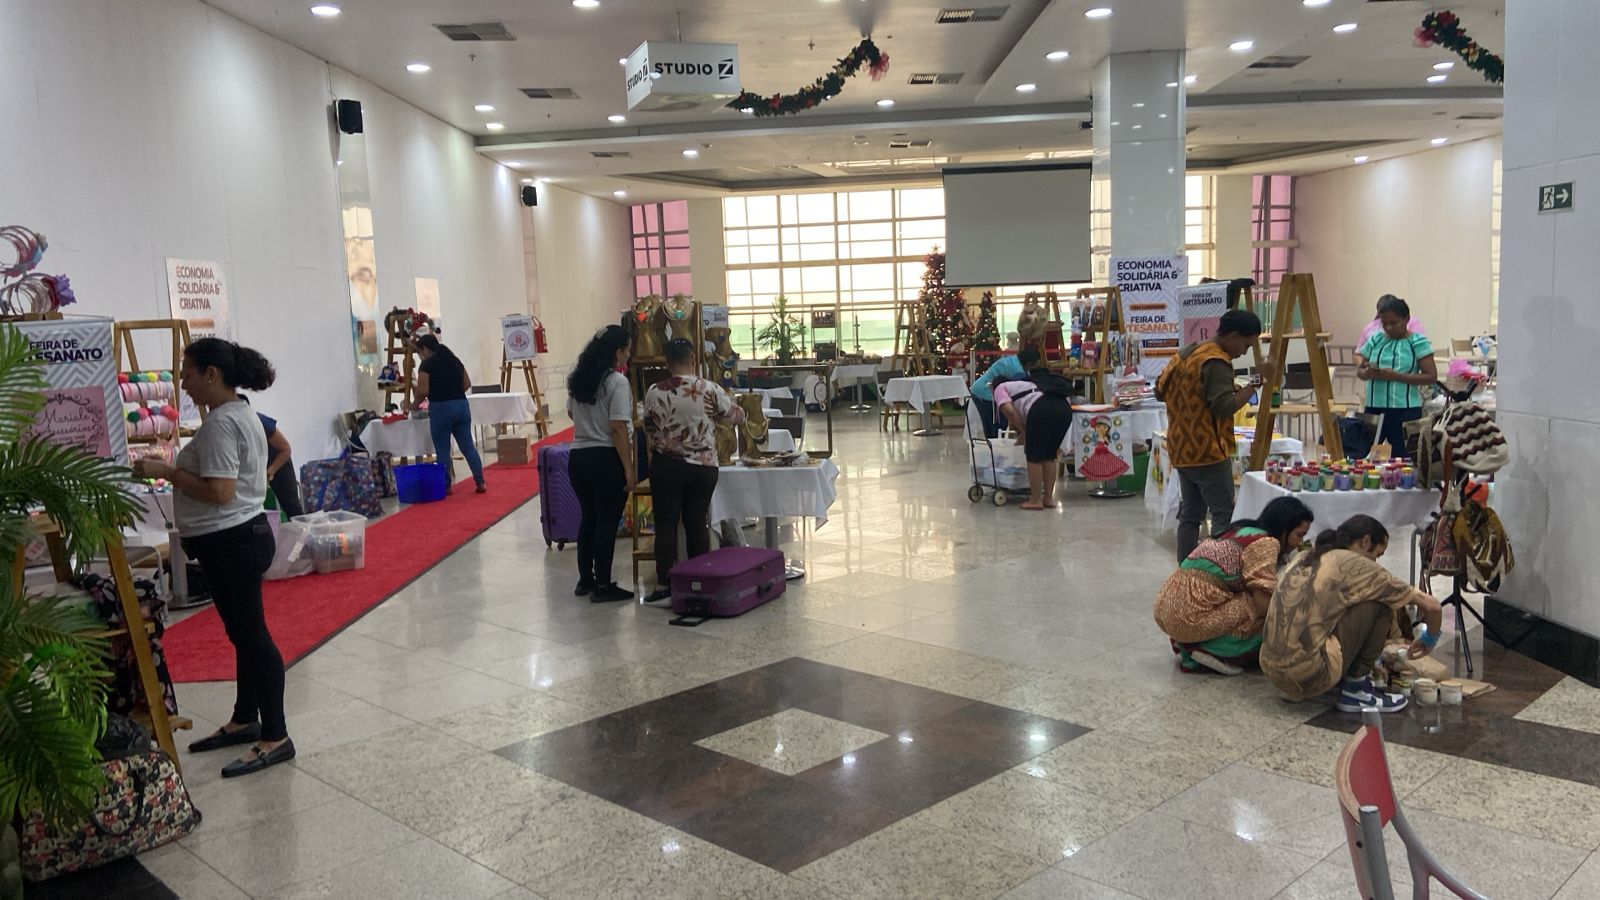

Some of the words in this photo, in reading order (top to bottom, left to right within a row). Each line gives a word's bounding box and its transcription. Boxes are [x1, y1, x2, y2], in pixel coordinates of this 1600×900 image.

[654, 62, 713, 75] STUDIO
[627, 68, 643, 92] STUDIO
[1117, 259, 1172, 270] ECONOMIA
[176, 265, 214, 280] ECONOMIA
[1117, 269, 1170, 281] SOLIDÁRIA
[1171, 270, 1179, 280] &
[177, 279, 214, 295] SOLIDÁRIA
[1118, 282, 1162, 292] CRIATIVA
[179, 297, 211, 310] CRIATIVA
[1130, 315, 1153, 324] FEIRA
[1154, 315, 1166, 323] DE
[29, 340, 62, 351] FEIRA
[62, 338, 78, 349] DE
